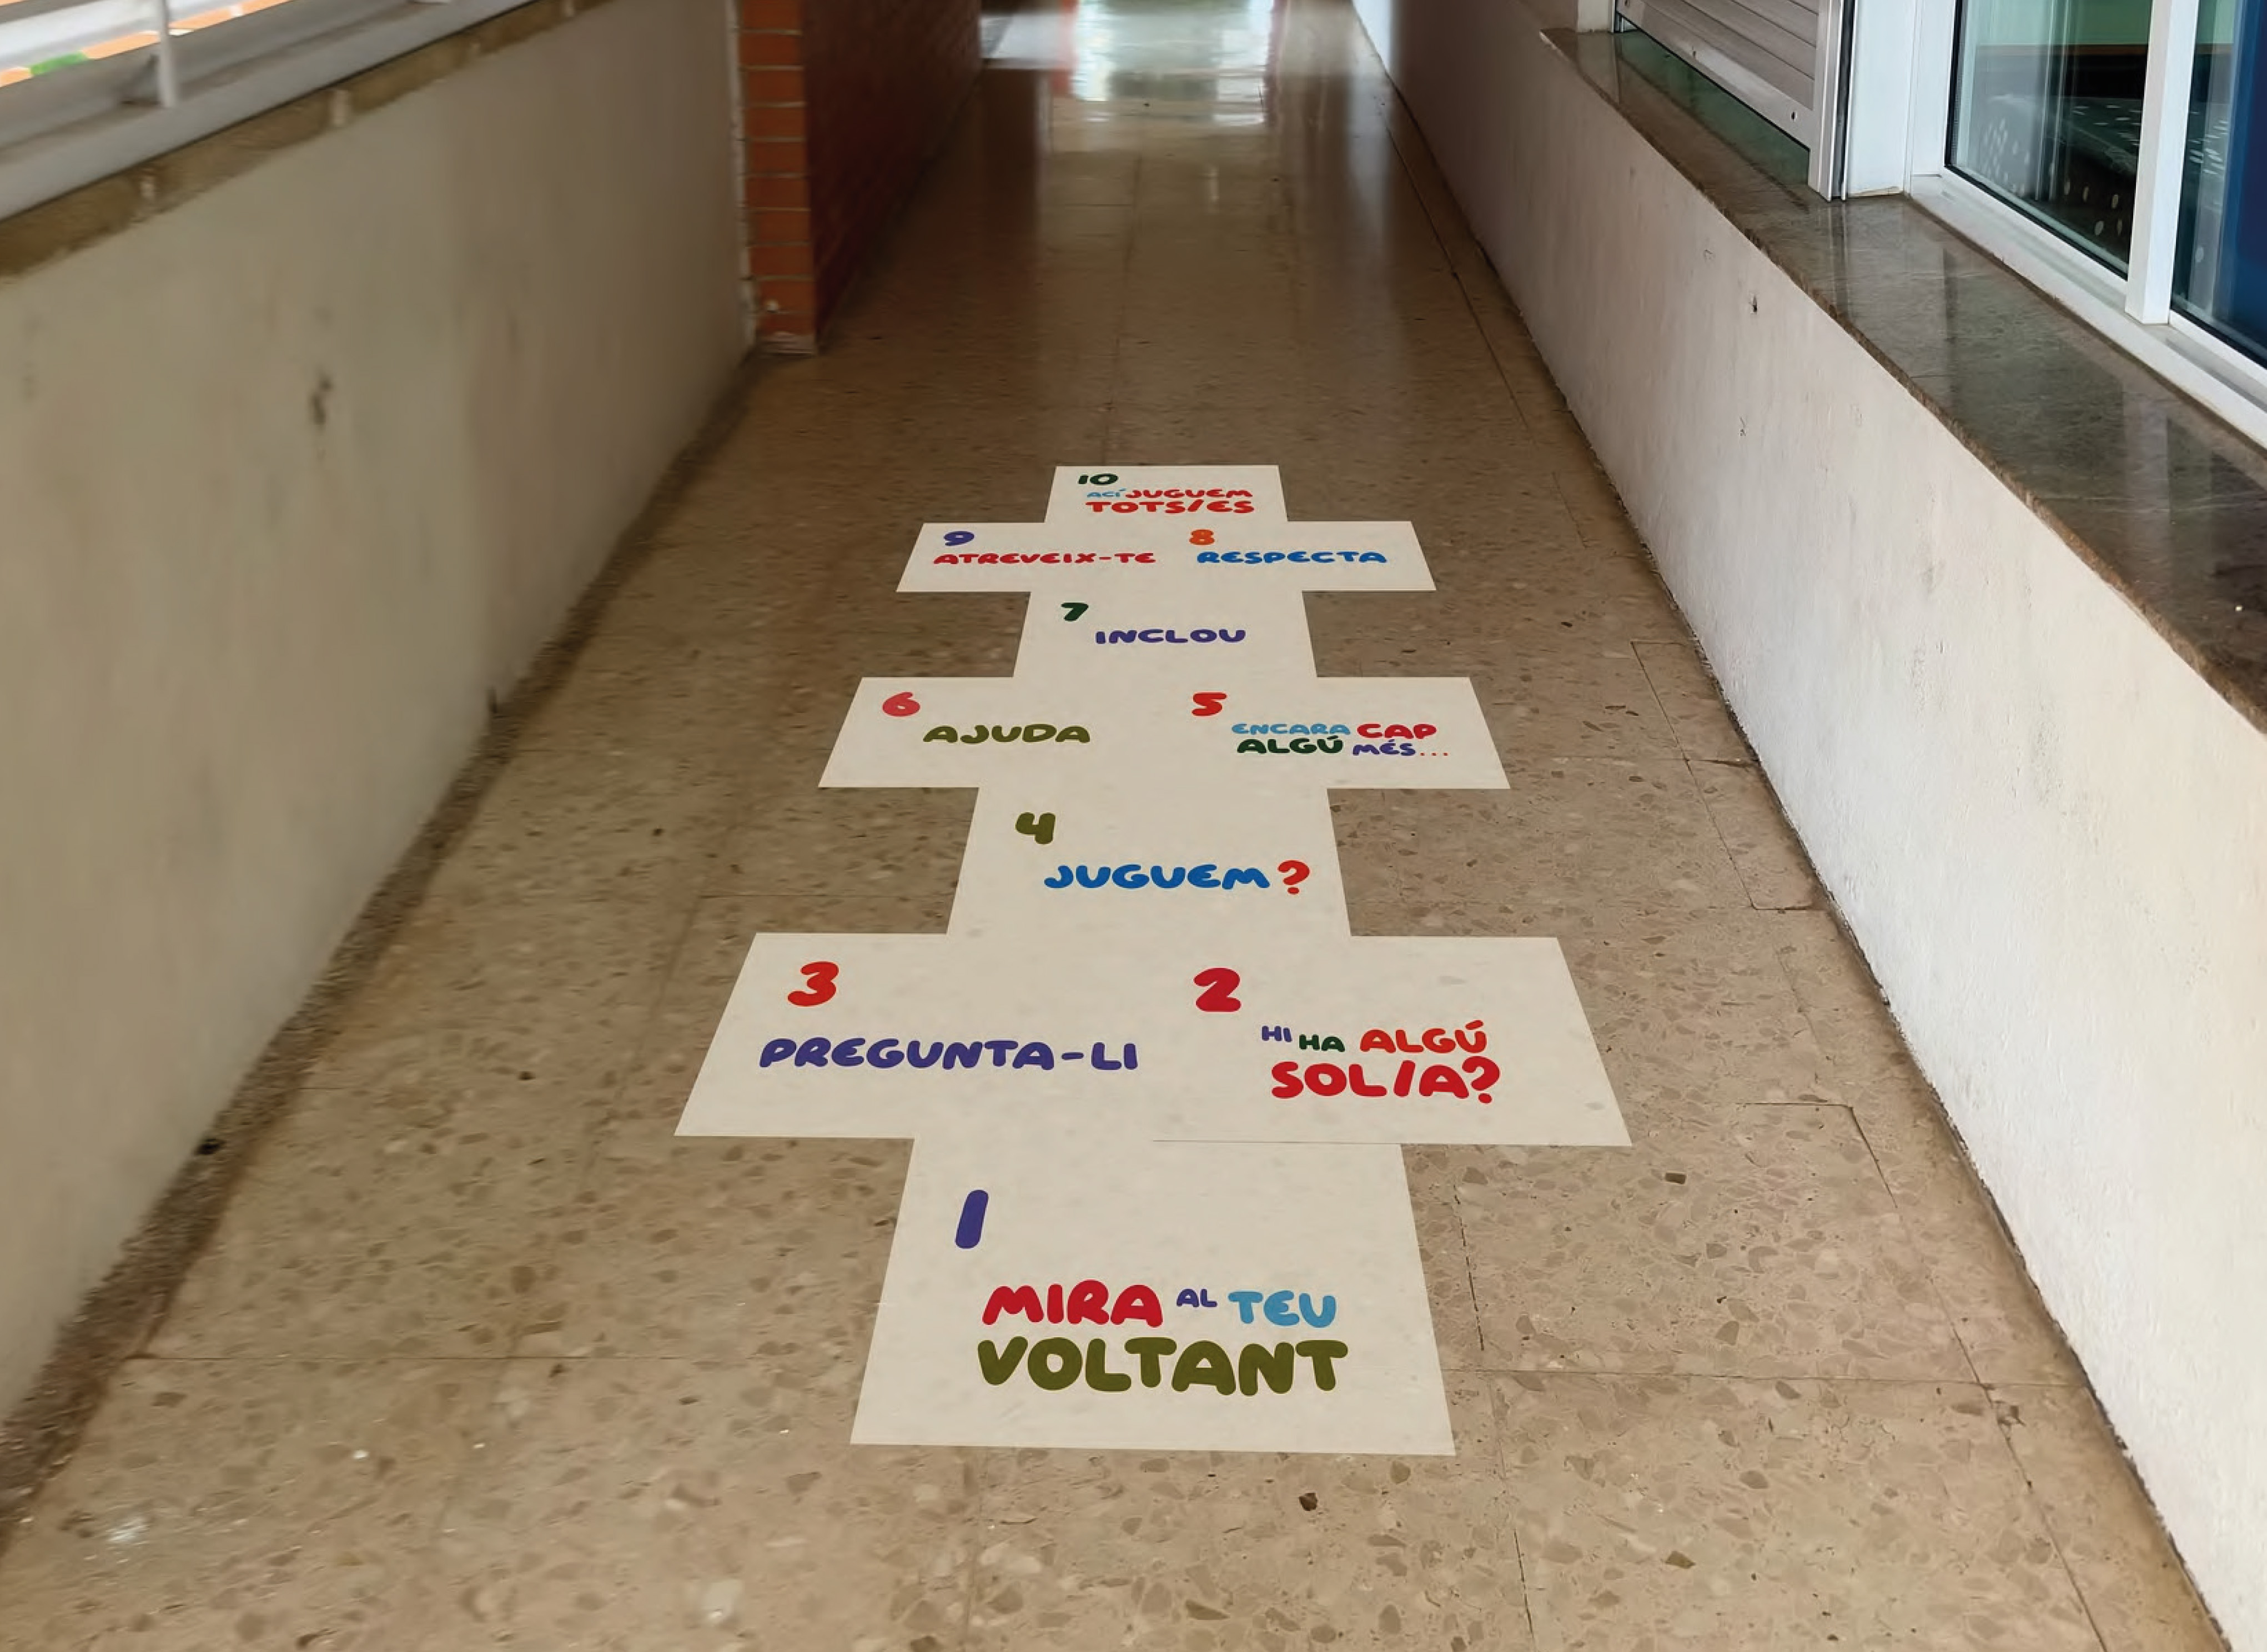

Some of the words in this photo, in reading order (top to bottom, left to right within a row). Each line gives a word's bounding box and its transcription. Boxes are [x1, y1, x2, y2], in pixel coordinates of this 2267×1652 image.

[1078, 473, 1119, 485] 10
[1125, 489, 1253, 499] JUGUEM
[1085, 500, 1254, 514] TOTS/ES
[943, 531, 974, 546] 9
[1189, 529, 1215, 546] 8
[933, 553, 1156, 564] ATREVEIX-TE
[1197, 551, 1388, 564] RESPECTA
[1061, 602, 1089, 622] 7
[1095, 629, 1245, 644] INCLOU
[882, 692, 921, 717] 6
[1192, 692, 1228, 717] 5
[923, 724, 1090, 745] AJUDA
[1231, 723, 1350, 735] ENCARA
[1357, 724, 1437, 741] CAP
[1237, 735, 1344, 754] ALGÚ
[1015, 812, 1055, 845] 4
[787, 961, 839, 1007] 3
[1193, 968, 1241, 1012] 2
[1262, 1026, 1293, 1042] HI
[1299, 1034, 1345, 1052] HA
[1360, 1020, 1487, 1053] ALGÚ
[759, 1037, 1138, 1070] PREGUNTA-LI
[1271, 1056, 1501, 1104] SOL/A?
[954, 1189, 989, 1249] 1
[982, 1279, 1163, 1328] MIRA
[1177, 1289, 1218, 1307] AL
[1228, 1291, 1336, 1328] TEU
[977, 1336, 1348, 1397] VOLTANT
